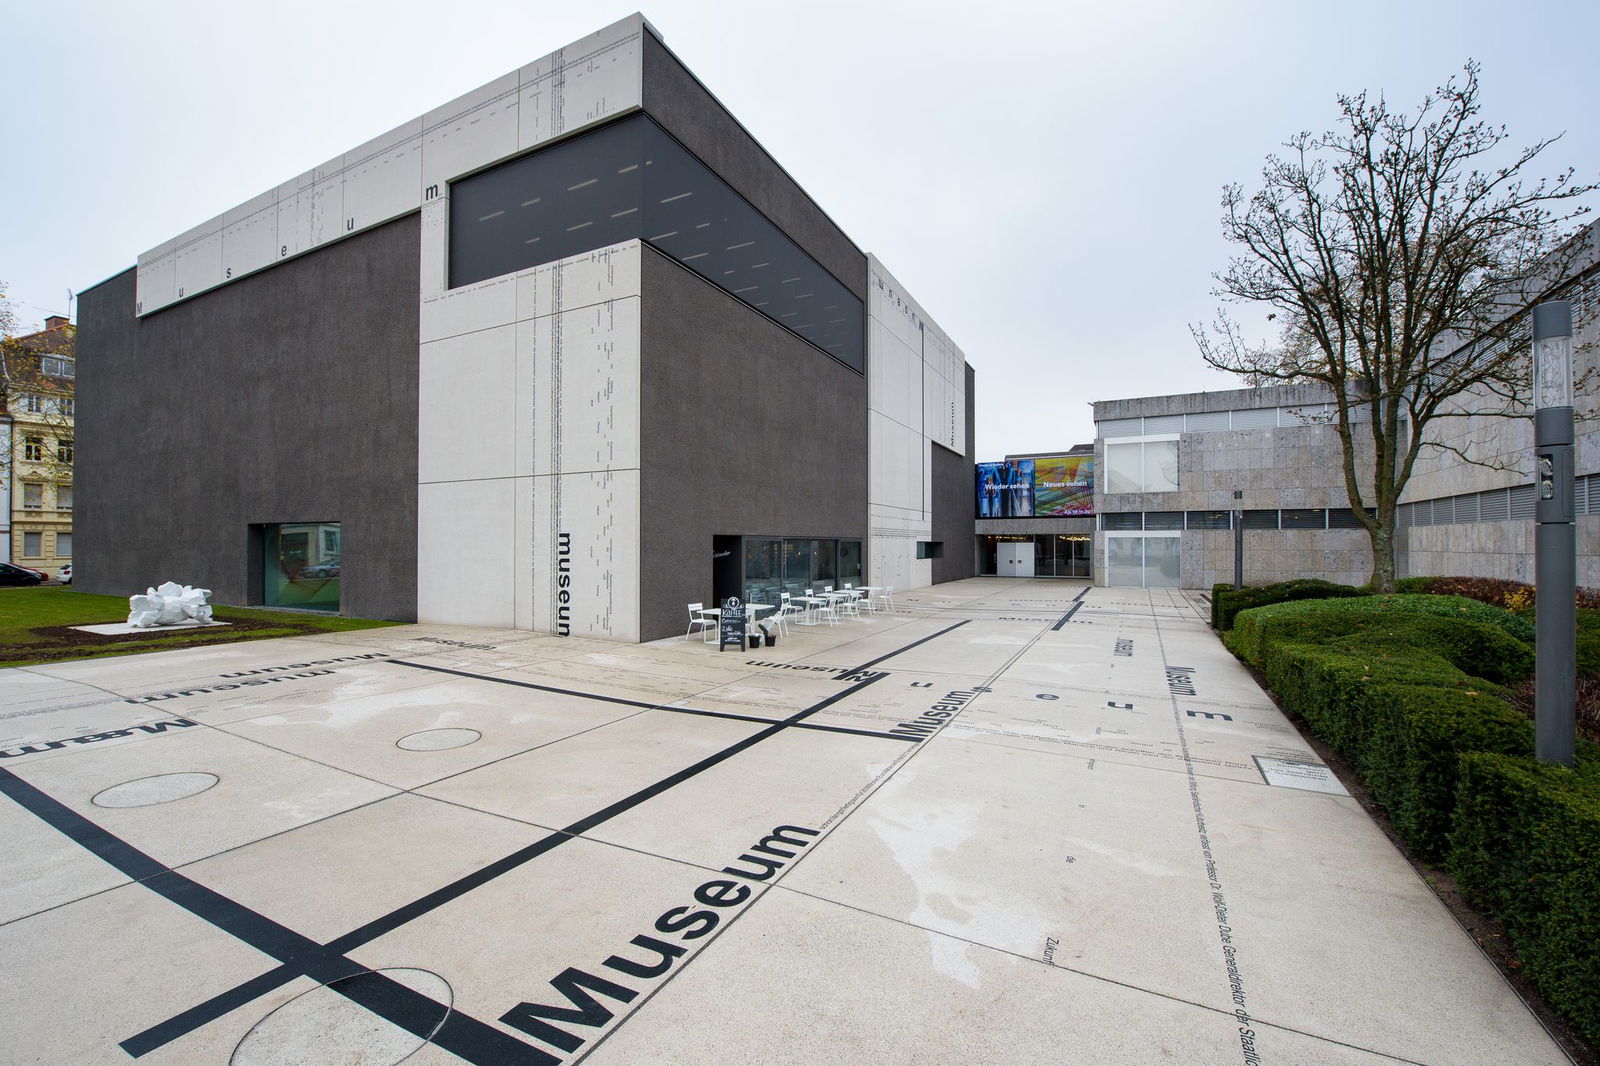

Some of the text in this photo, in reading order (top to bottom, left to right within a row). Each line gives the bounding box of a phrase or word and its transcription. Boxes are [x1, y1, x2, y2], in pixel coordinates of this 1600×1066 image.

[1165, 665, 1197, 696] Museum
[889, 690, 976, 737] Museum
[497, 823, 821, 1054] Museum
[1219, 924, 1232, 944] Dube
[1041, 936, 1060, 966] Zukunf
[1222, 945, 1246, 1008] Generaldirektor
[1235, 1008, 1250, 1027] der
